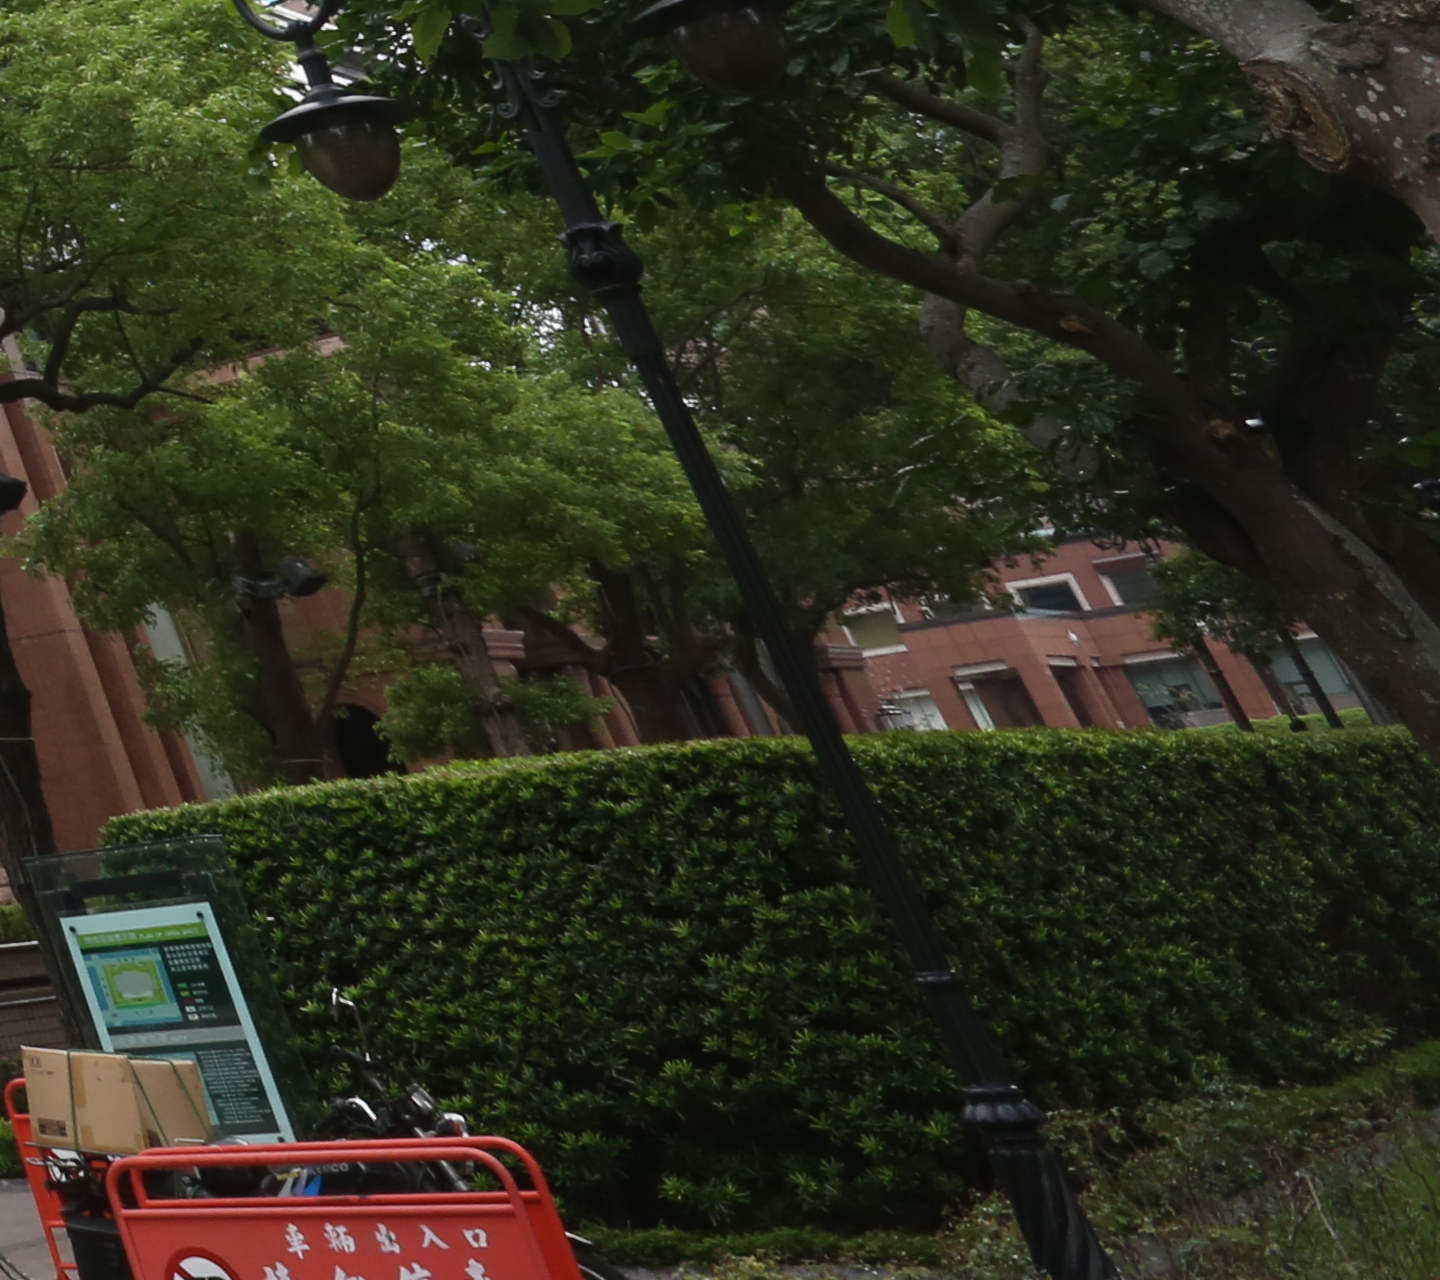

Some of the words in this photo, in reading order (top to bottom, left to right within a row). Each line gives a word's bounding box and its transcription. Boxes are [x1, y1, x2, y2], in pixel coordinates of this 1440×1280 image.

[285, 1222, 489, 1260] 車輛出入口
